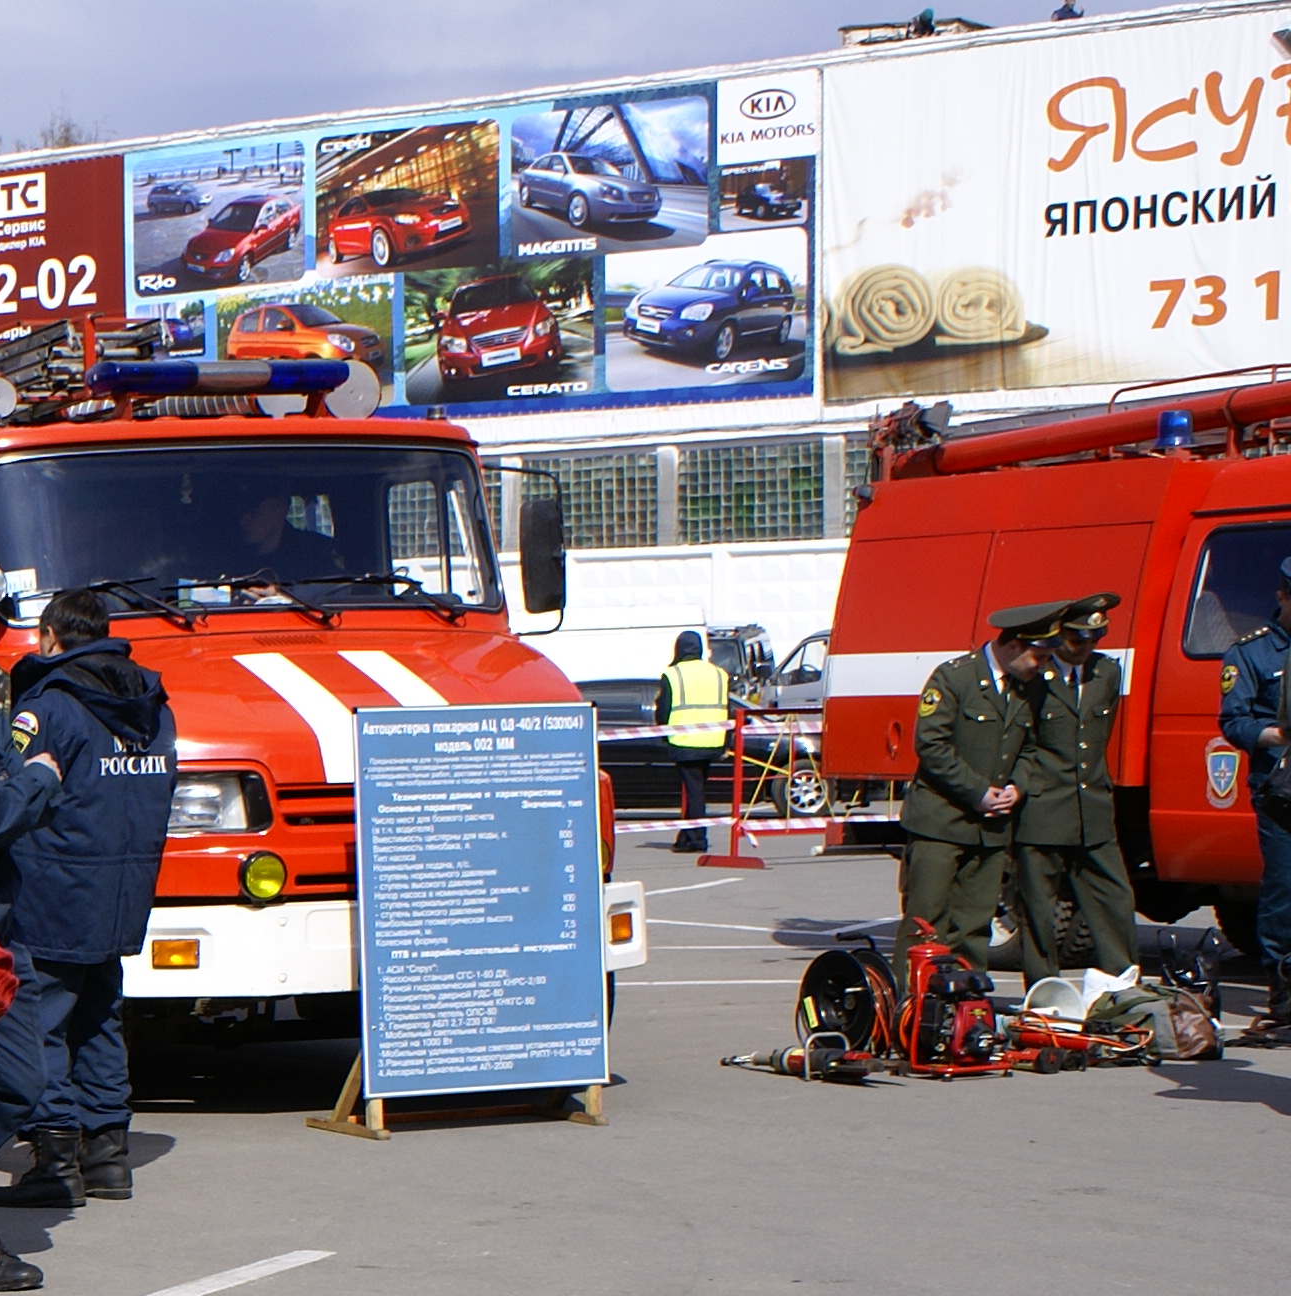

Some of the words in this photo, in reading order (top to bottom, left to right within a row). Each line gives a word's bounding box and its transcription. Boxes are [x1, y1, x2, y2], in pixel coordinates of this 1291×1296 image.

[750, 95, 787, 114] KIA
[720, 131, 745, 145] KIA
[750, 122, 816, 142] MOTORS
[1044, 173, 1277, 238] ЯПОНСКИЙ
[137, 274, 177, 293] Rio
[705, 357, 790, 374] CARENS
[506, 380, 588, 397] CERATO
[362, 720, 430, 735] Автоцистерна
[432, 721, 479, 734] пожарная
[481, 718, 498, 733] АЦ
[434, 740, 472, 753] модель
[474, 738, 493, 750] 002
[496, 737, 514, 749] ММ
[99, 755, 167, 776] РОССИИ
